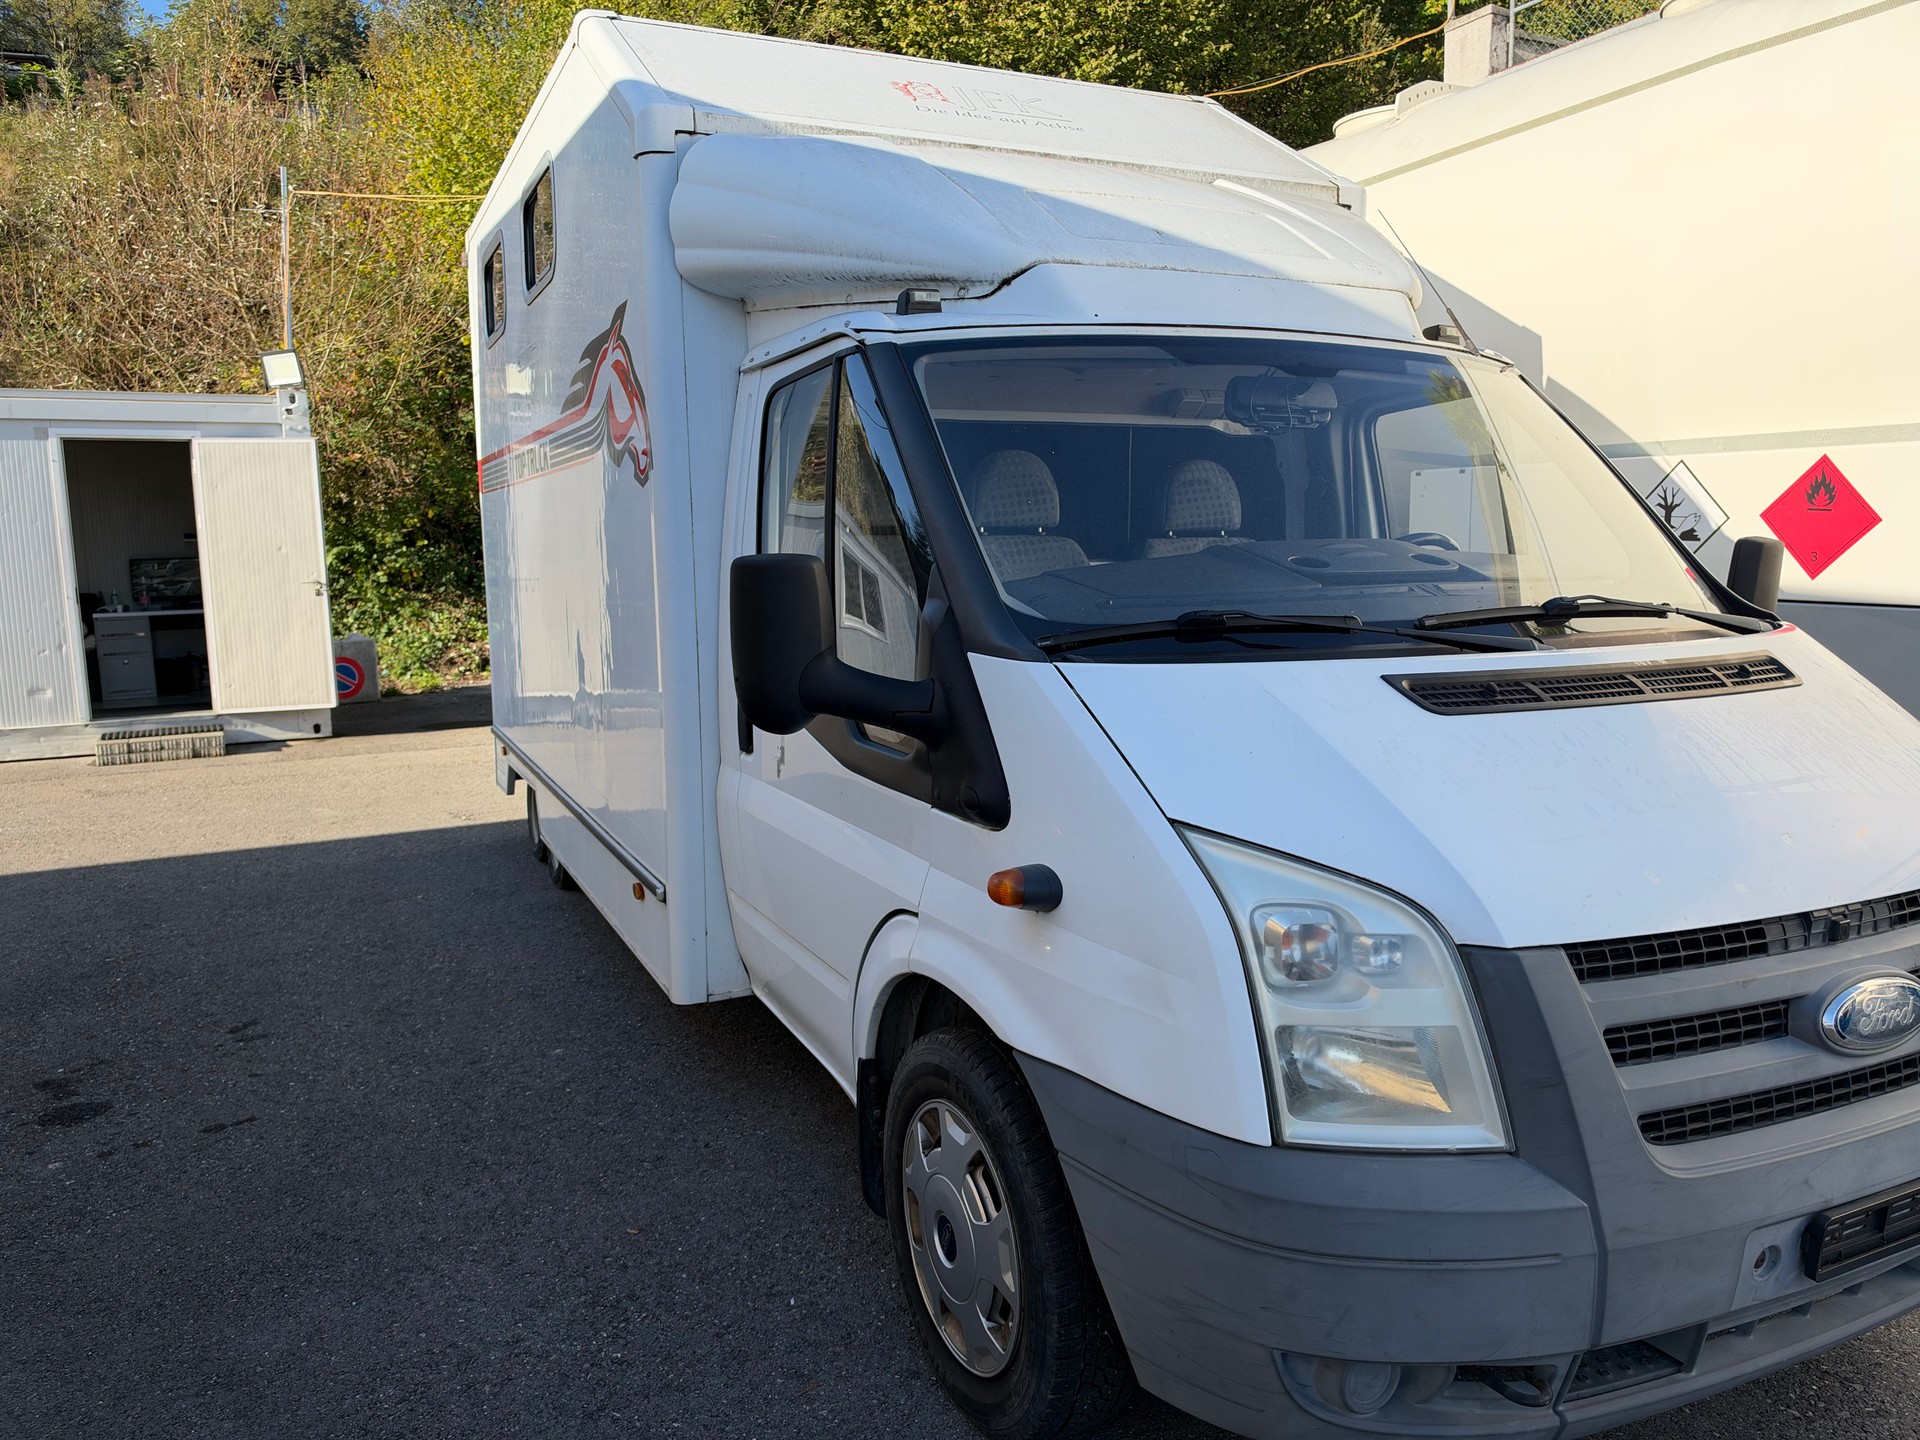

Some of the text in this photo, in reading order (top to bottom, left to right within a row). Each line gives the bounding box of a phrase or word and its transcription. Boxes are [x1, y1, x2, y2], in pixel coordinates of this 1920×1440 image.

[952, 86, 1063, 117] JFK
[915, 104, 1085, 132] Die Idee auf Achse
[1810, 551, 1818, 562] 3
[1860, 992, 1915, 1035] Ford
